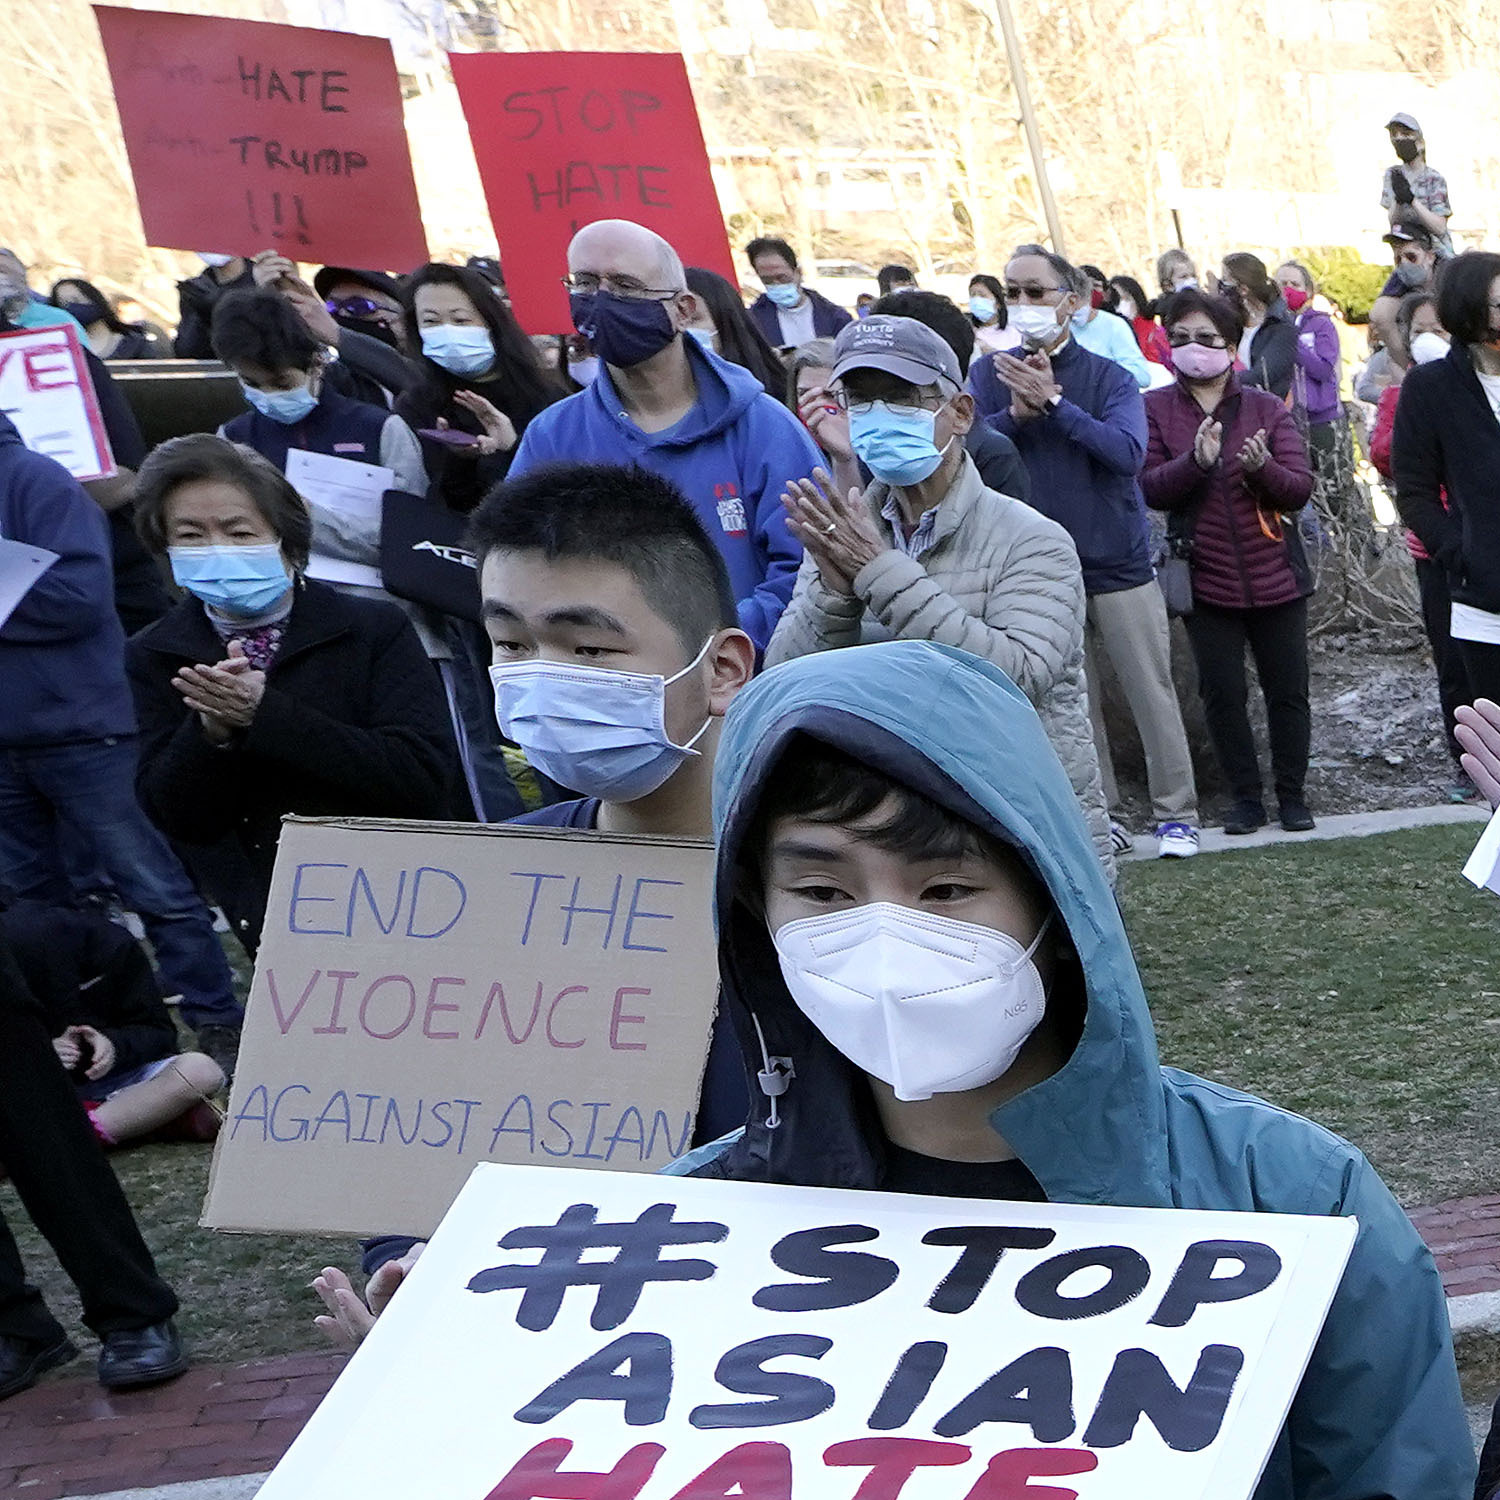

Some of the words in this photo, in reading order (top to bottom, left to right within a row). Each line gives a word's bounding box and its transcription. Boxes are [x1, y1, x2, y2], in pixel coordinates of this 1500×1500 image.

[238, 55, 349, 113] HATE
[503, 85, 663, 142] STOP
[527, 160, 672, 212] HATE
[288, 863, 467, 938] END
[510, 872, 684, 953] THE
[266, 969, 652, 1051] VIOENCE
[230, 1085, 482, 1154] AGAINST
[489, 1094, 695, 1162] ASIAN
[514, 1332, 1244, 1452] ASIAN
